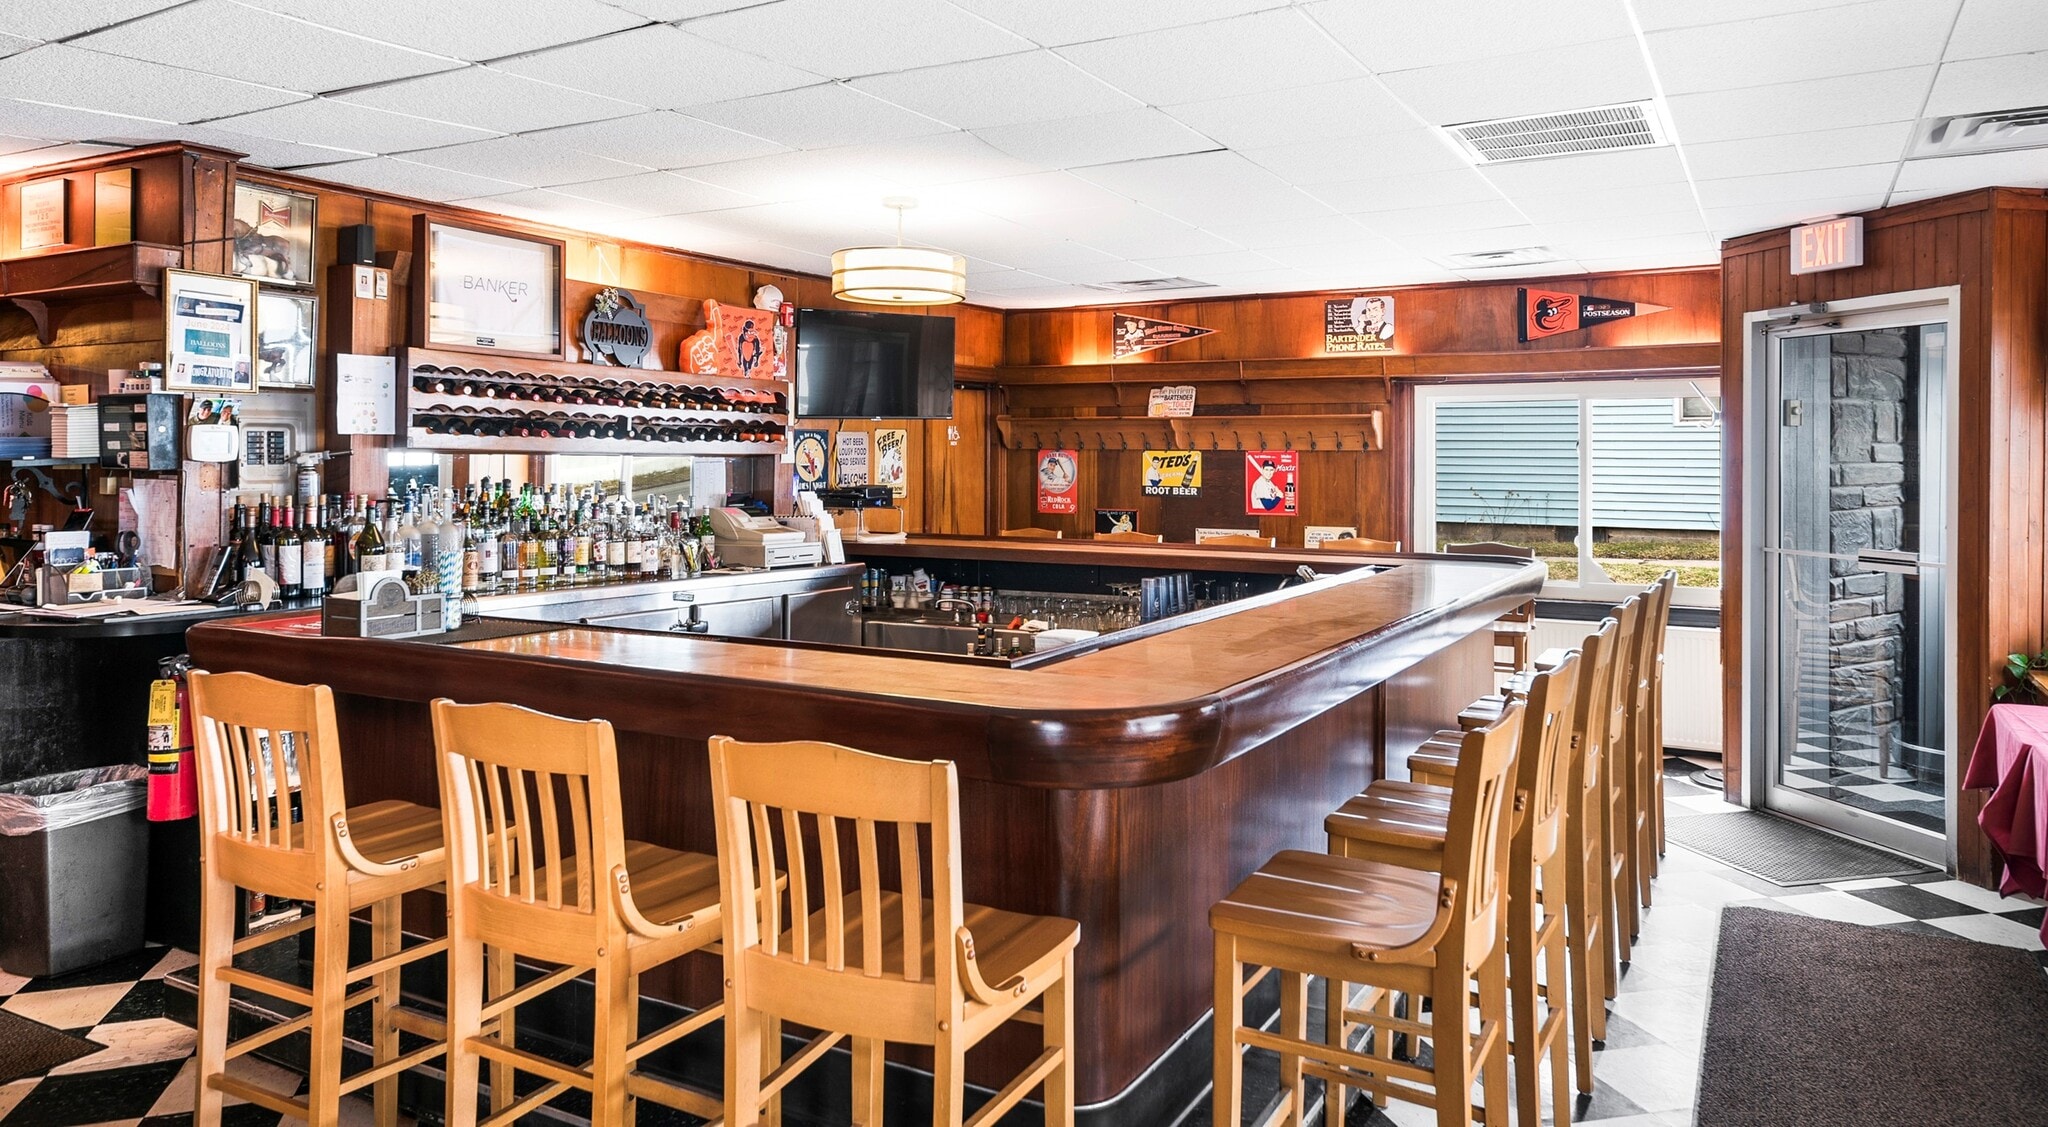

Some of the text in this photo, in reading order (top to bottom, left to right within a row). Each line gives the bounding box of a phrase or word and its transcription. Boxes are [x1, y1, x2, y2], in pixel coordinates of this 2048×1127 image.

[1801, 221, 1847, 269] EXIT
[463, 275, 528, 303] BANKER
[1582, 309, 1631, 318] POSTSEASON
[592, 321, 647, 348] BALLOONS
[1325, 334, 1377, 343] BARTENDER
[190, 339, 226, 349] BALLOONS
[1326, 343, 1356, 352] PHONE
[842, 438, 864, 446] HOT BEER
[877, 431, 896, 452] FREE
[881, 434, 904, 458] BEER!
[839, 447, 867, 456] LOUSY FOOD
[840, 458, 866, 466] BAD SERVICE
[1159, 454, 1192, 469] TED'S
[838, 473, 867, 485] WELCOME
[1145, 486, 1198, 496] ROOT BEER
